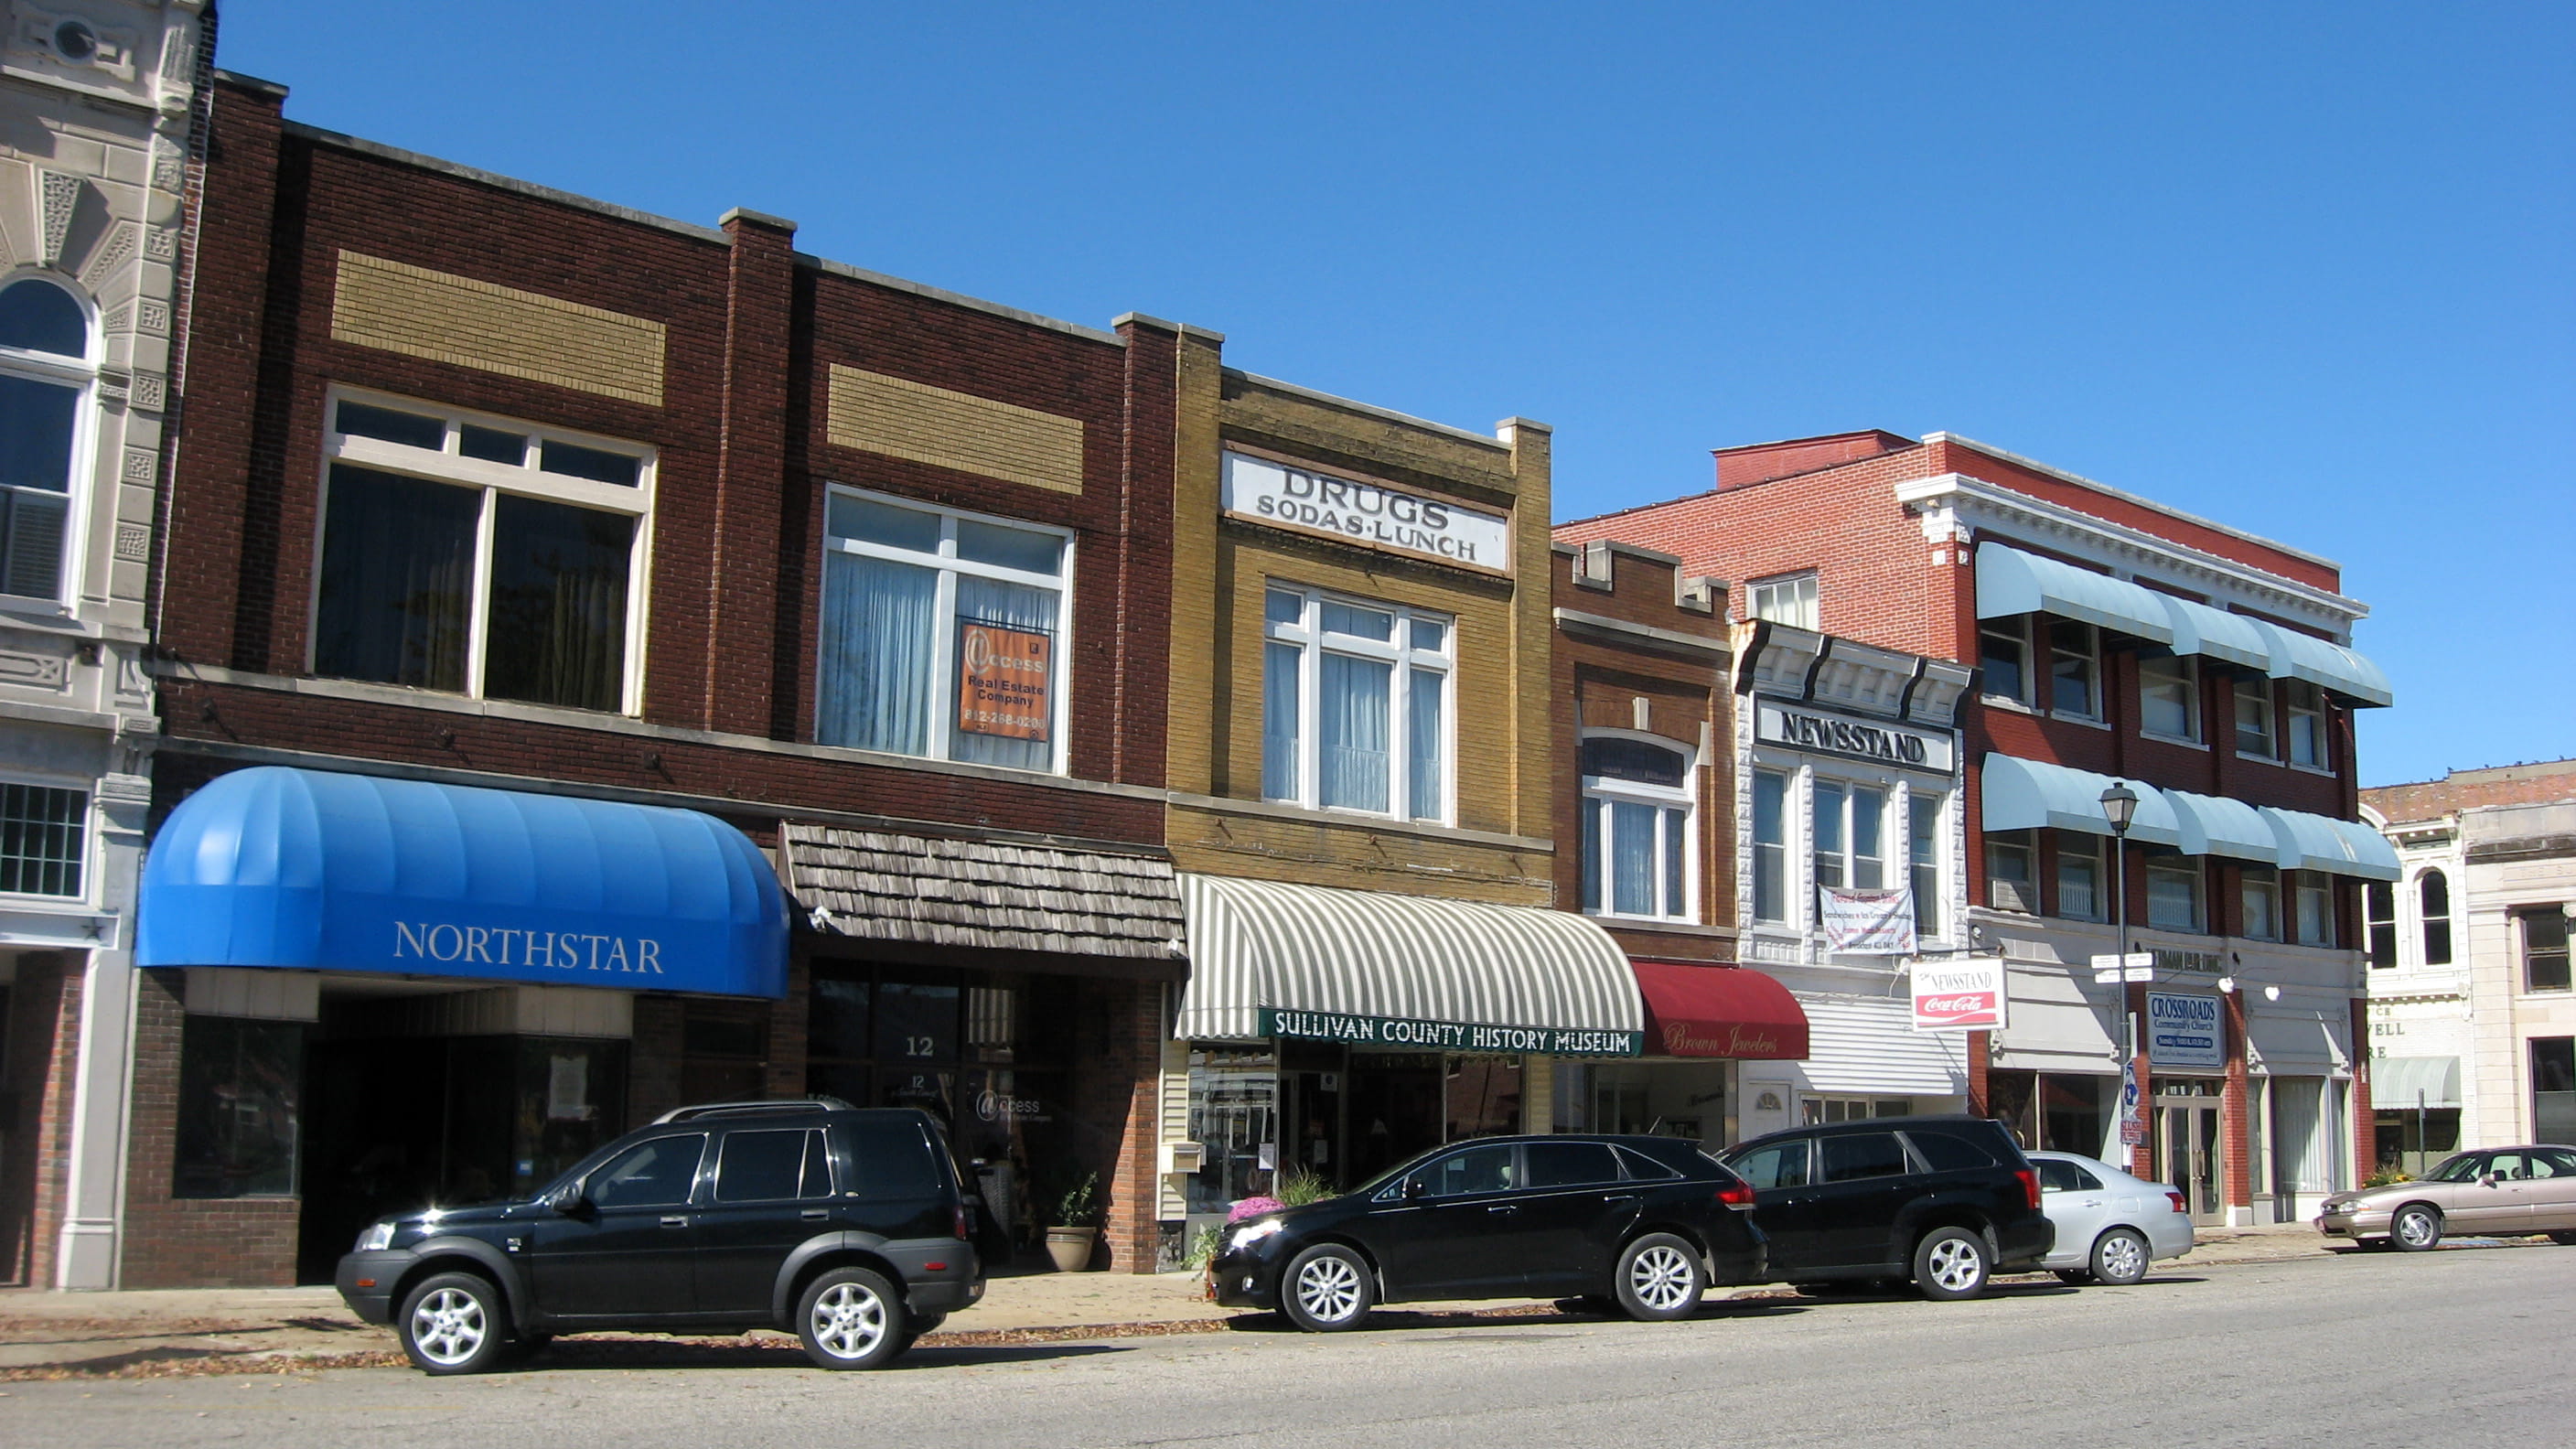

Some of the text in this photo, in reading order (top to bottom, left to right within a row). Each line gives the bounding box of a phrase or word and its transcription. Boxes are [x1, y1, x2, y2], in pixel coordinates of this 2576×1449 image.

[1283, 467, 1450, 531] DRUGS
[969, 675, 1045, 695] Real Estate
[978, 690, 1034, 708] Company
[1782, 712, 1927, 763] NEWSSTAND
[393, 921, 664, 973] NORTHSTAR
[1932, 971, 1992, 992] NEWSSTAND
[2152, 997, 2216, 1021] CROSSROADS
[1275, 1012, 1631, 1053] SULLIVAN COUNTY HISTORY MUSEUM
[2154, 1019, 2214, 1033] Community Church
[907, 1036, 934, 1057] 12
[1664, 1022, 1778, 1057] Brown Jewelers
[913, 1075, 925, 1089] 12
